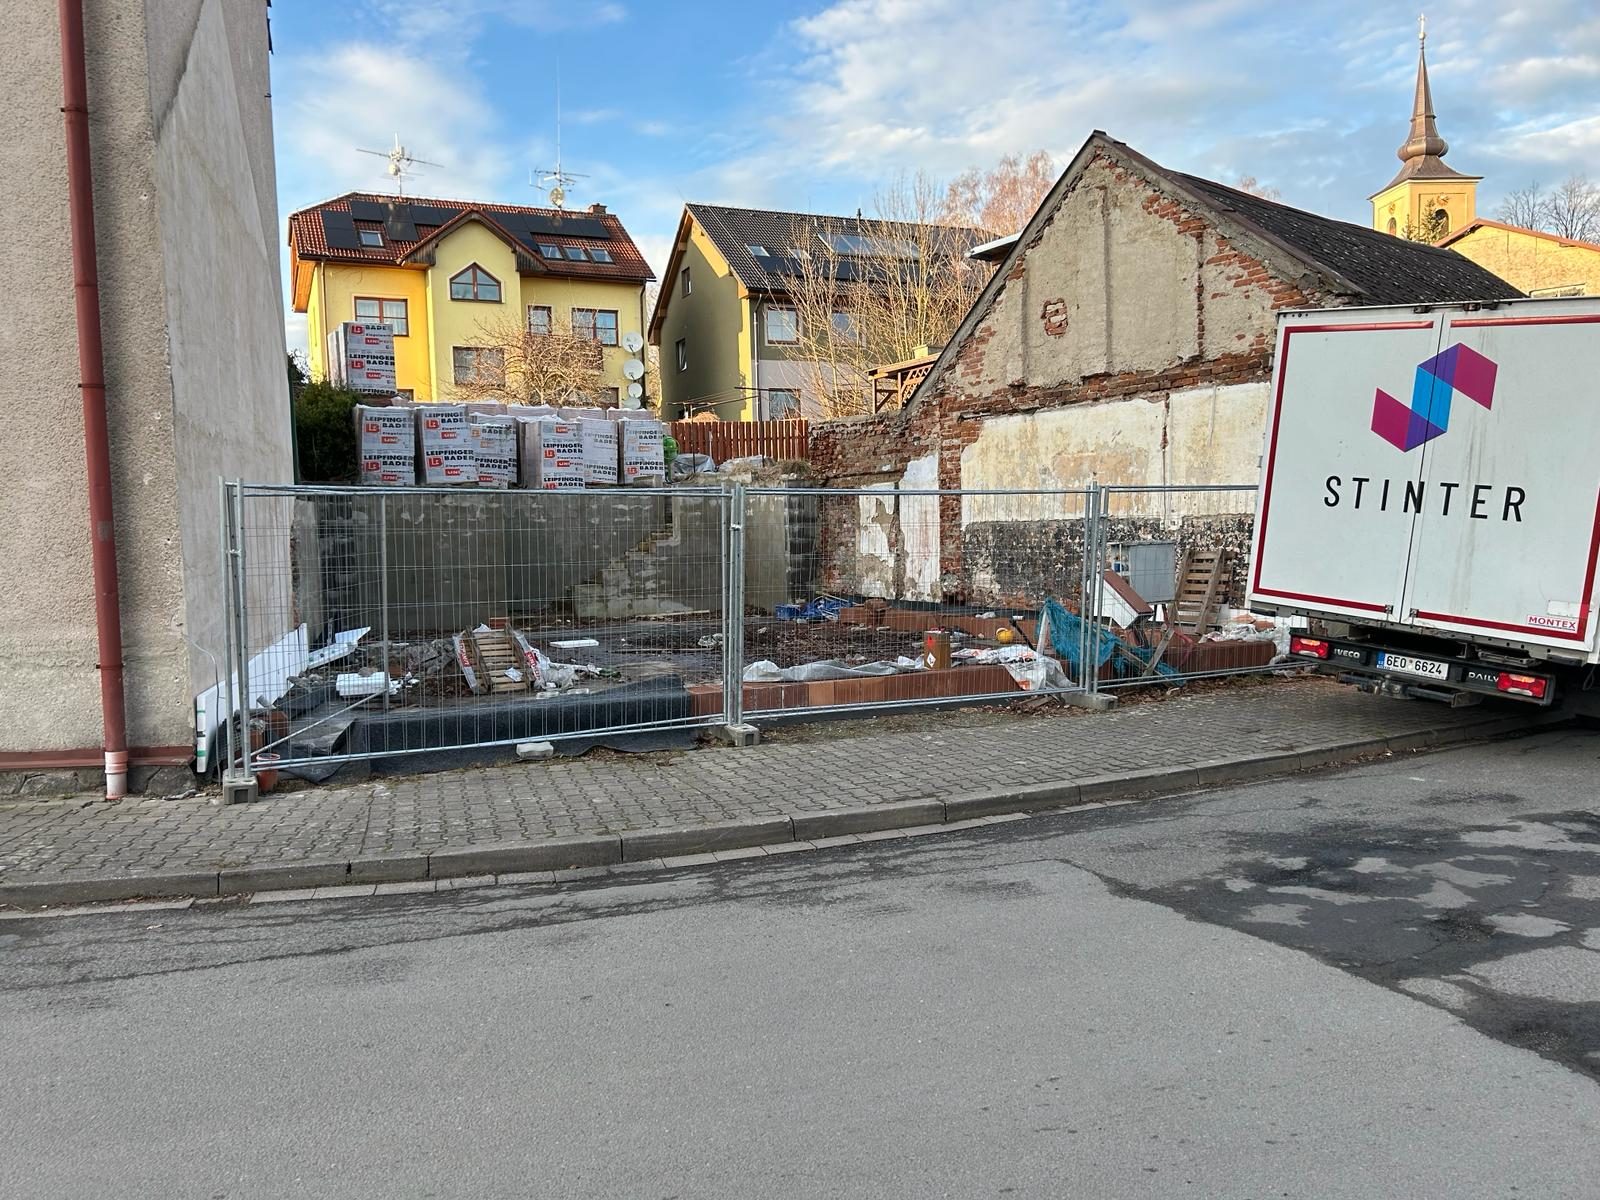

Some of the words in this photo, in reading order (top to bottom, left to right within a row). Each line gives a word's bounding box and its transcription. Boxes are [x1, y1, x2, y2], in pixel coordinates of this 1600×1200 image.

[349, 353, 395, 361] LEIPFINGER
[425, 449, 474, 457] LEIPFINGER
[363, 454, 415, 462] LEIPFINGER
[443, 454, 475, 462] BADER
[1323, 475, 1526, 522] STINTER
[1528, 616, 1577, 629] MONTEX
[1334, 648, 1361, 659] IVECO
[1414, 660, 1442, 675] 6624
